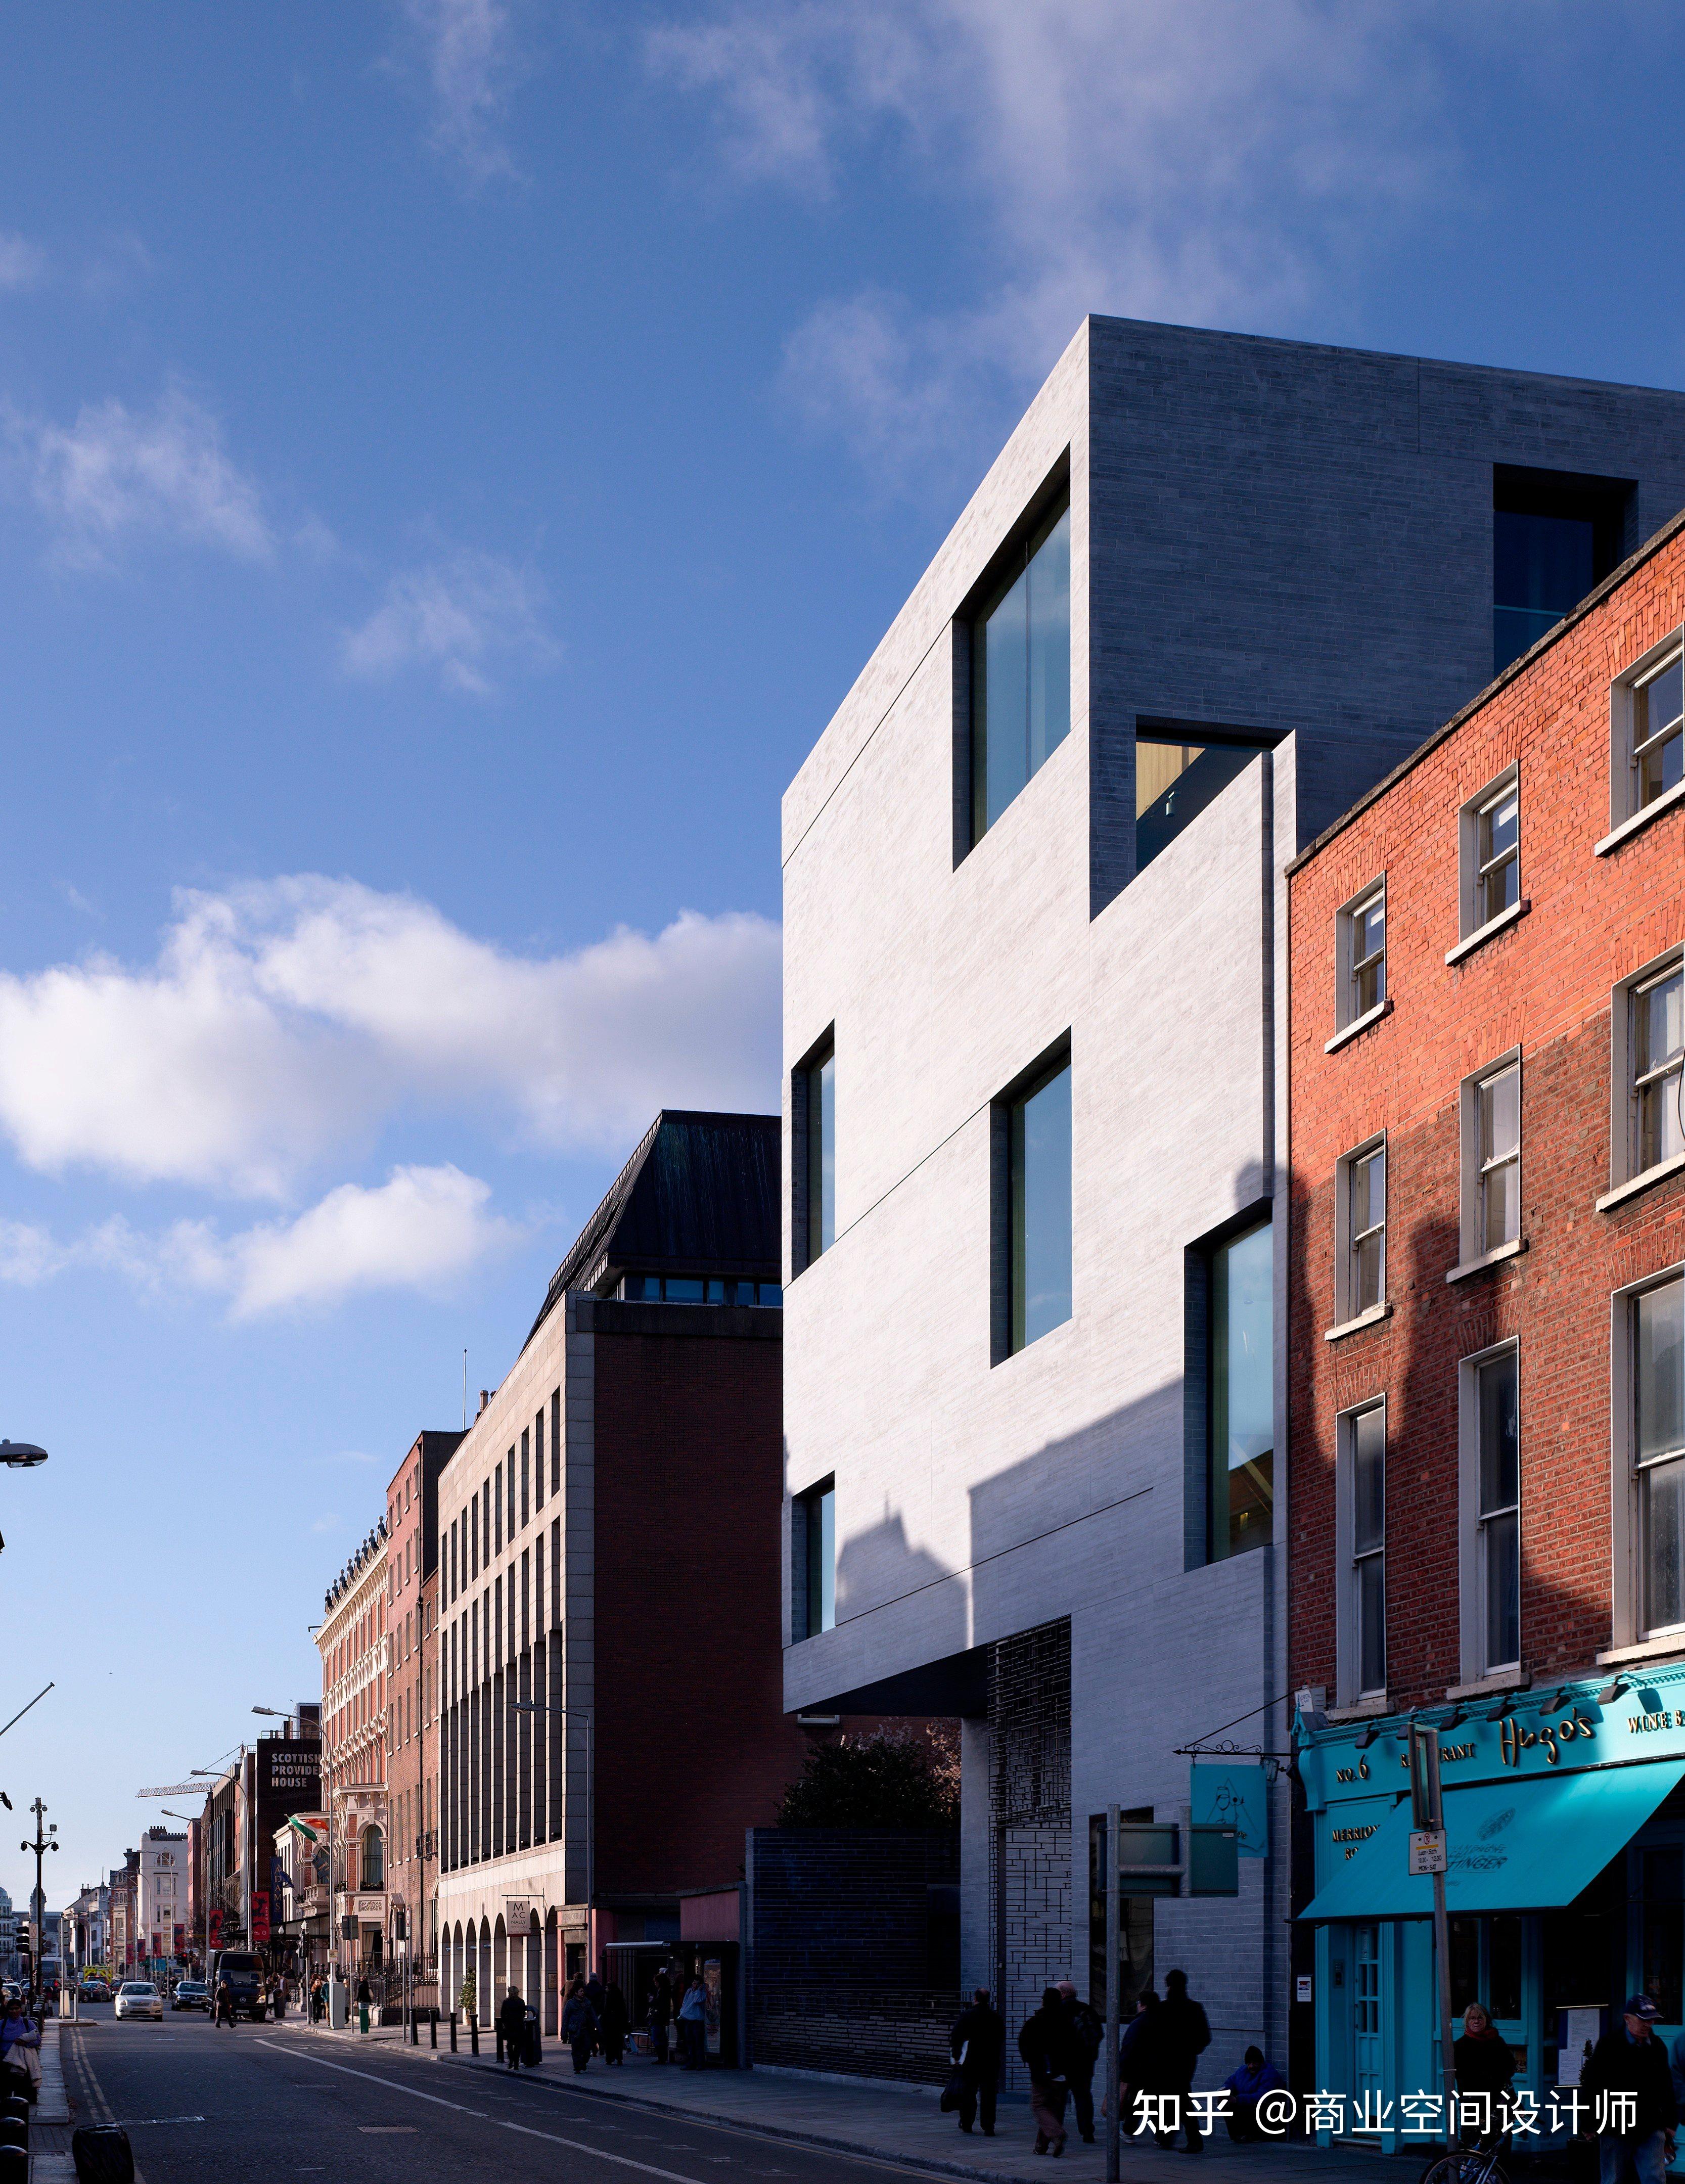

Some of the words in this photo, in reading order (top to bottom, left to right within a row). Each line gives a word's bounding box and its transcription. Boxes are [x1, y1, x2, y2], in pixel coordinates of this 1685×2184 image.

[1499, 1707, 1592, 1767] Hugo's
[1627, 1712, 1667, 1733] WINE
[272, 1753, 322, 1763] SCOTTISH
[272, 1765, 322, 1775] PROVIDE
[271, 1777, 307, 1787] HOUSE
[274, 1864, 282, 1910] ADAMS
